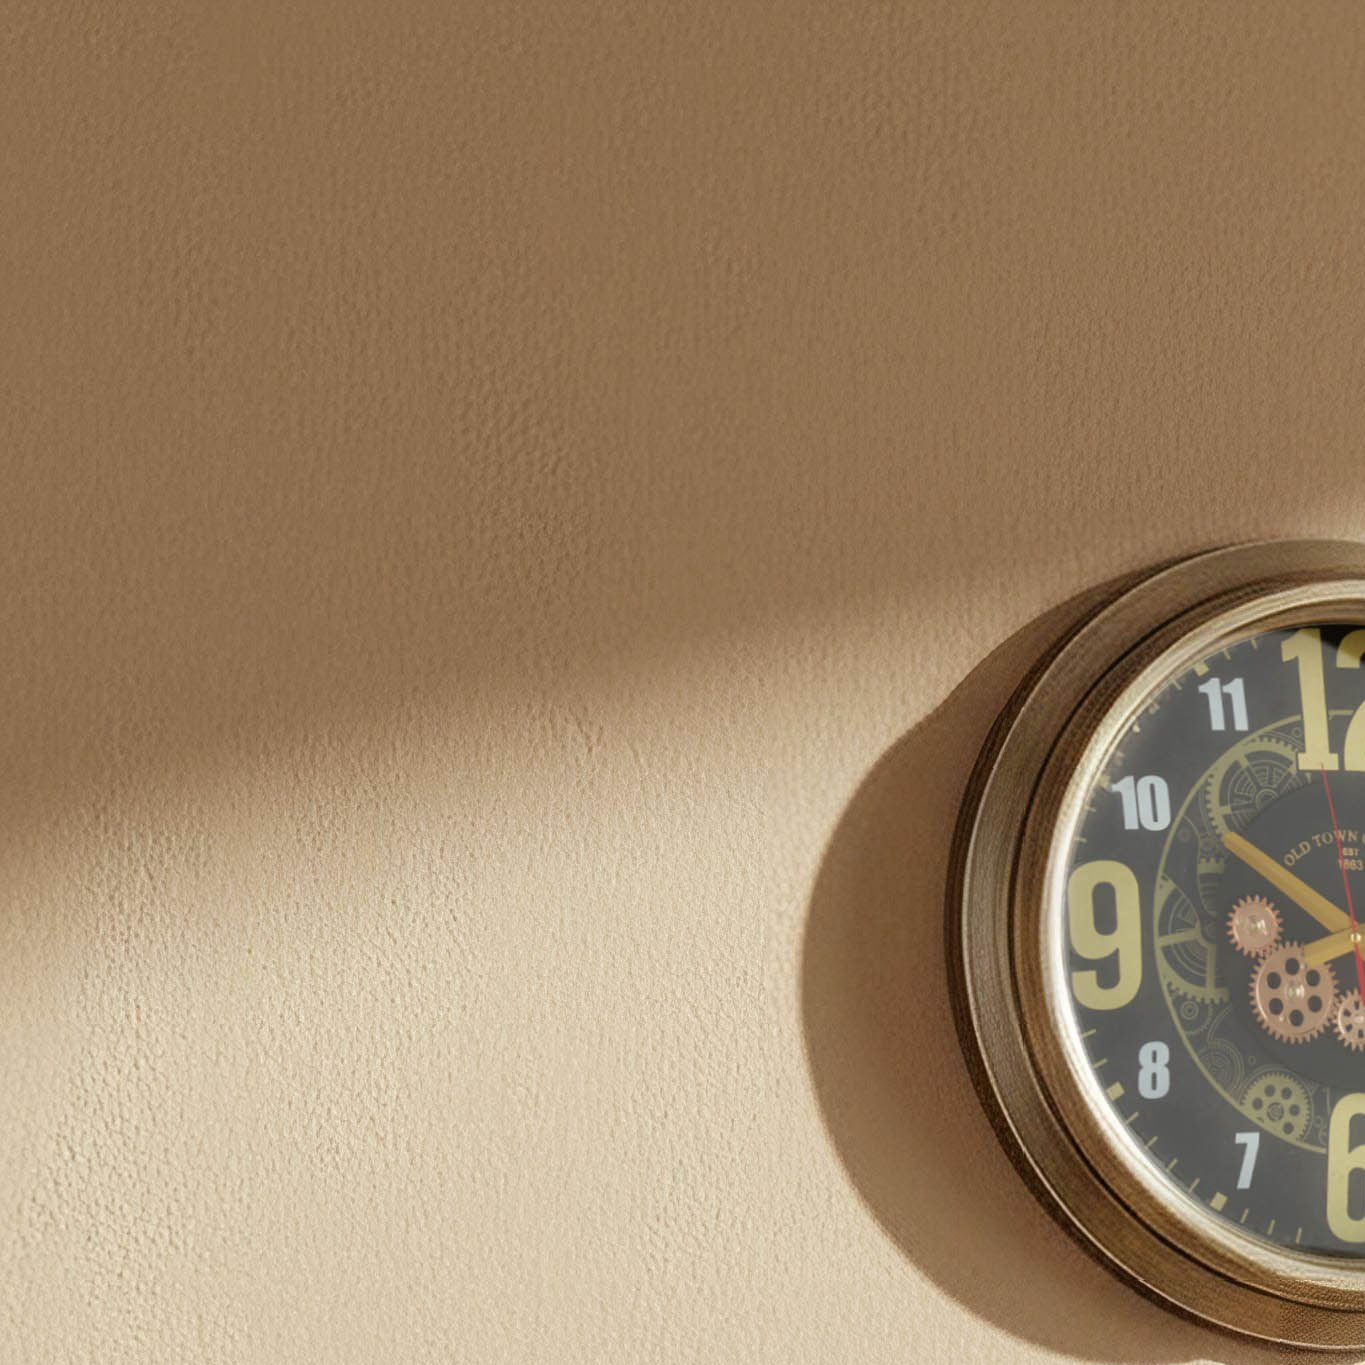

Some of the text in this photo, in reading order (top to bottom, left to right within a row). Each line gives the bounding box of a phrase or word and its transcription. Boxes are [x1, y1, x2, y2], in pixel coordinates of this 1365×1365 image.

[1199, 677, 1249, 731] 11
[1112, 775, 1171, 831] 10
[1284, 840, 1311, 866] OLD
[1312, 830, 1358, 847] TOWN
[1067, 859, 1142, 1010] 9
[1138, 1041, 1171, 1099] 8
[1235, 1132, 1260, 1189] 7
